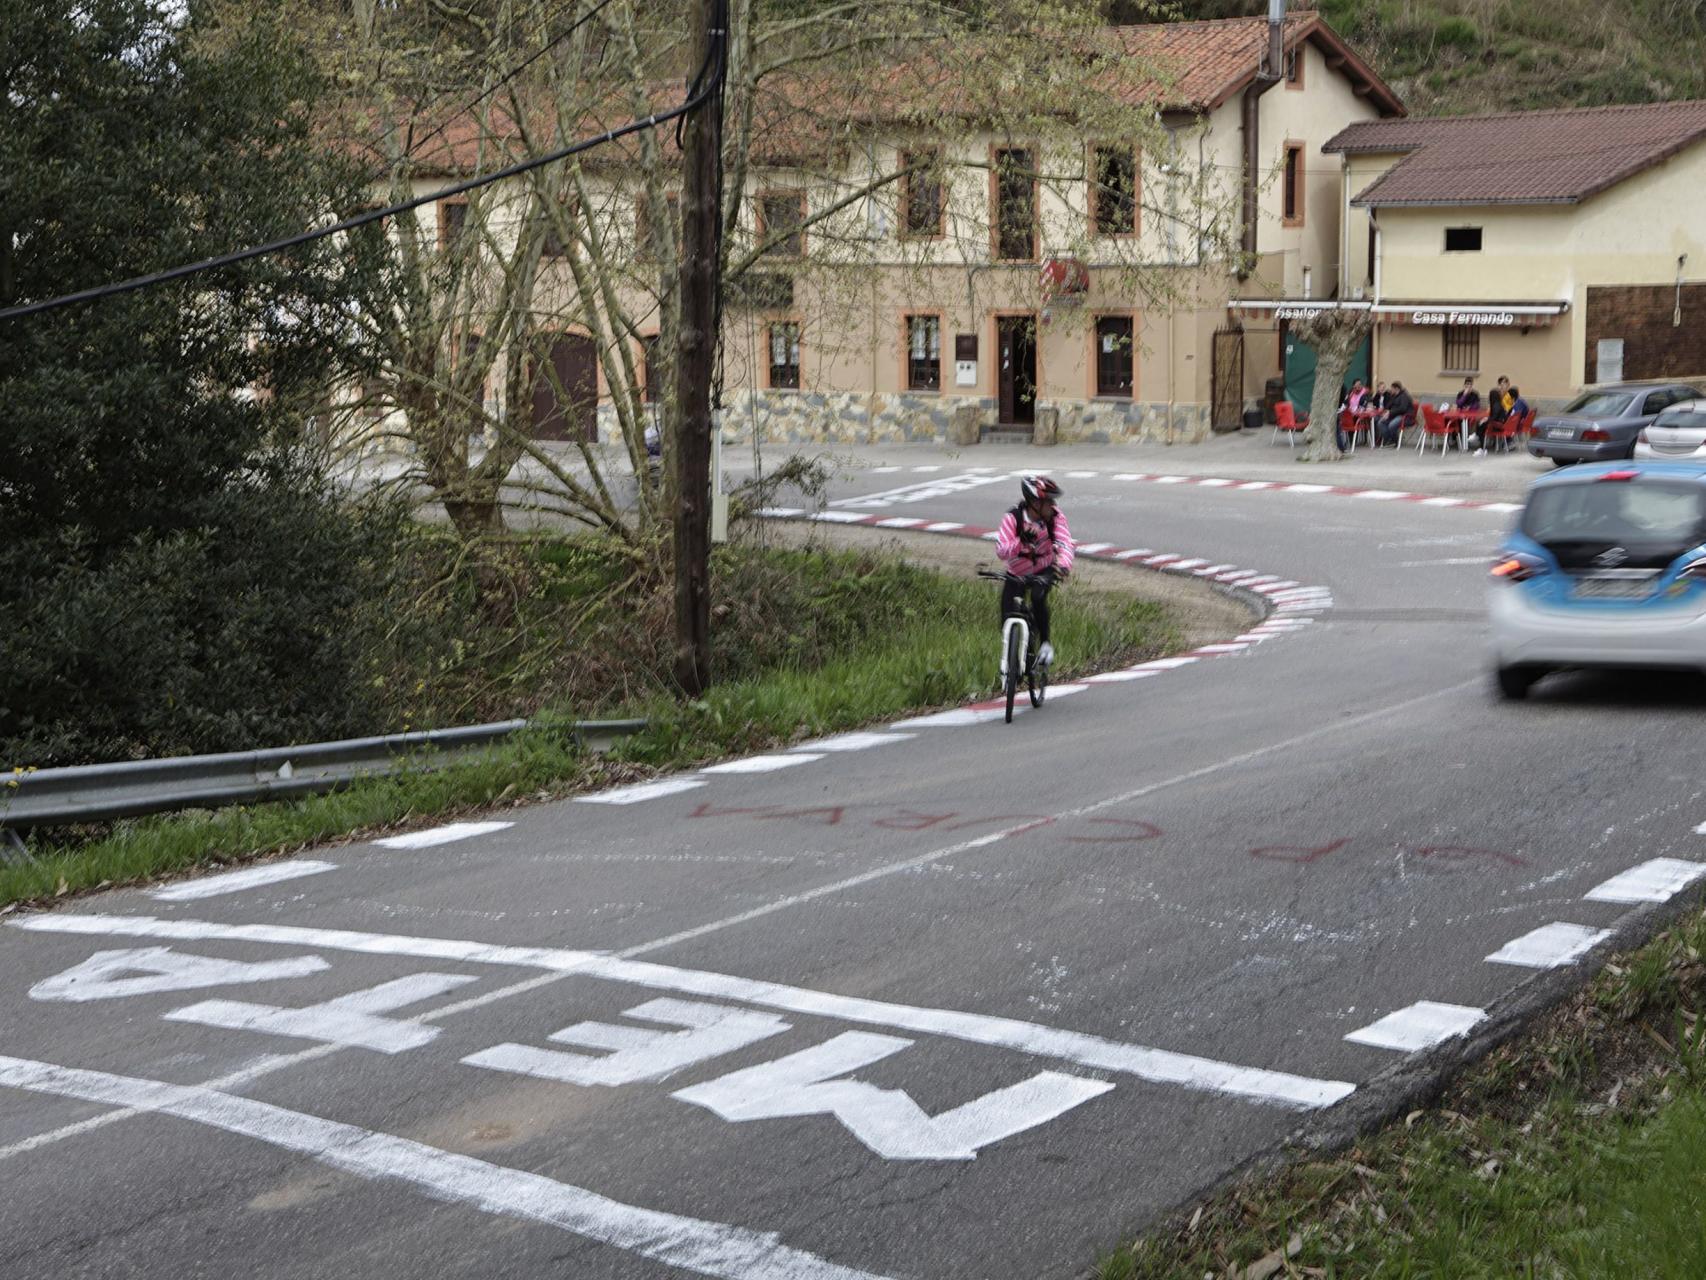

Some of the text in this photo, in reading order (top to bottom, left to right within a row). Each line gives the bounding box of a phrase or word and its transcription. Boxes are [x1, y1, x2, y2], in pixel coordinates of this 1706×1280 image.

[1412, 311, 1514, 326] Casa Fernando
[28, 946, 1115, 1161] META
